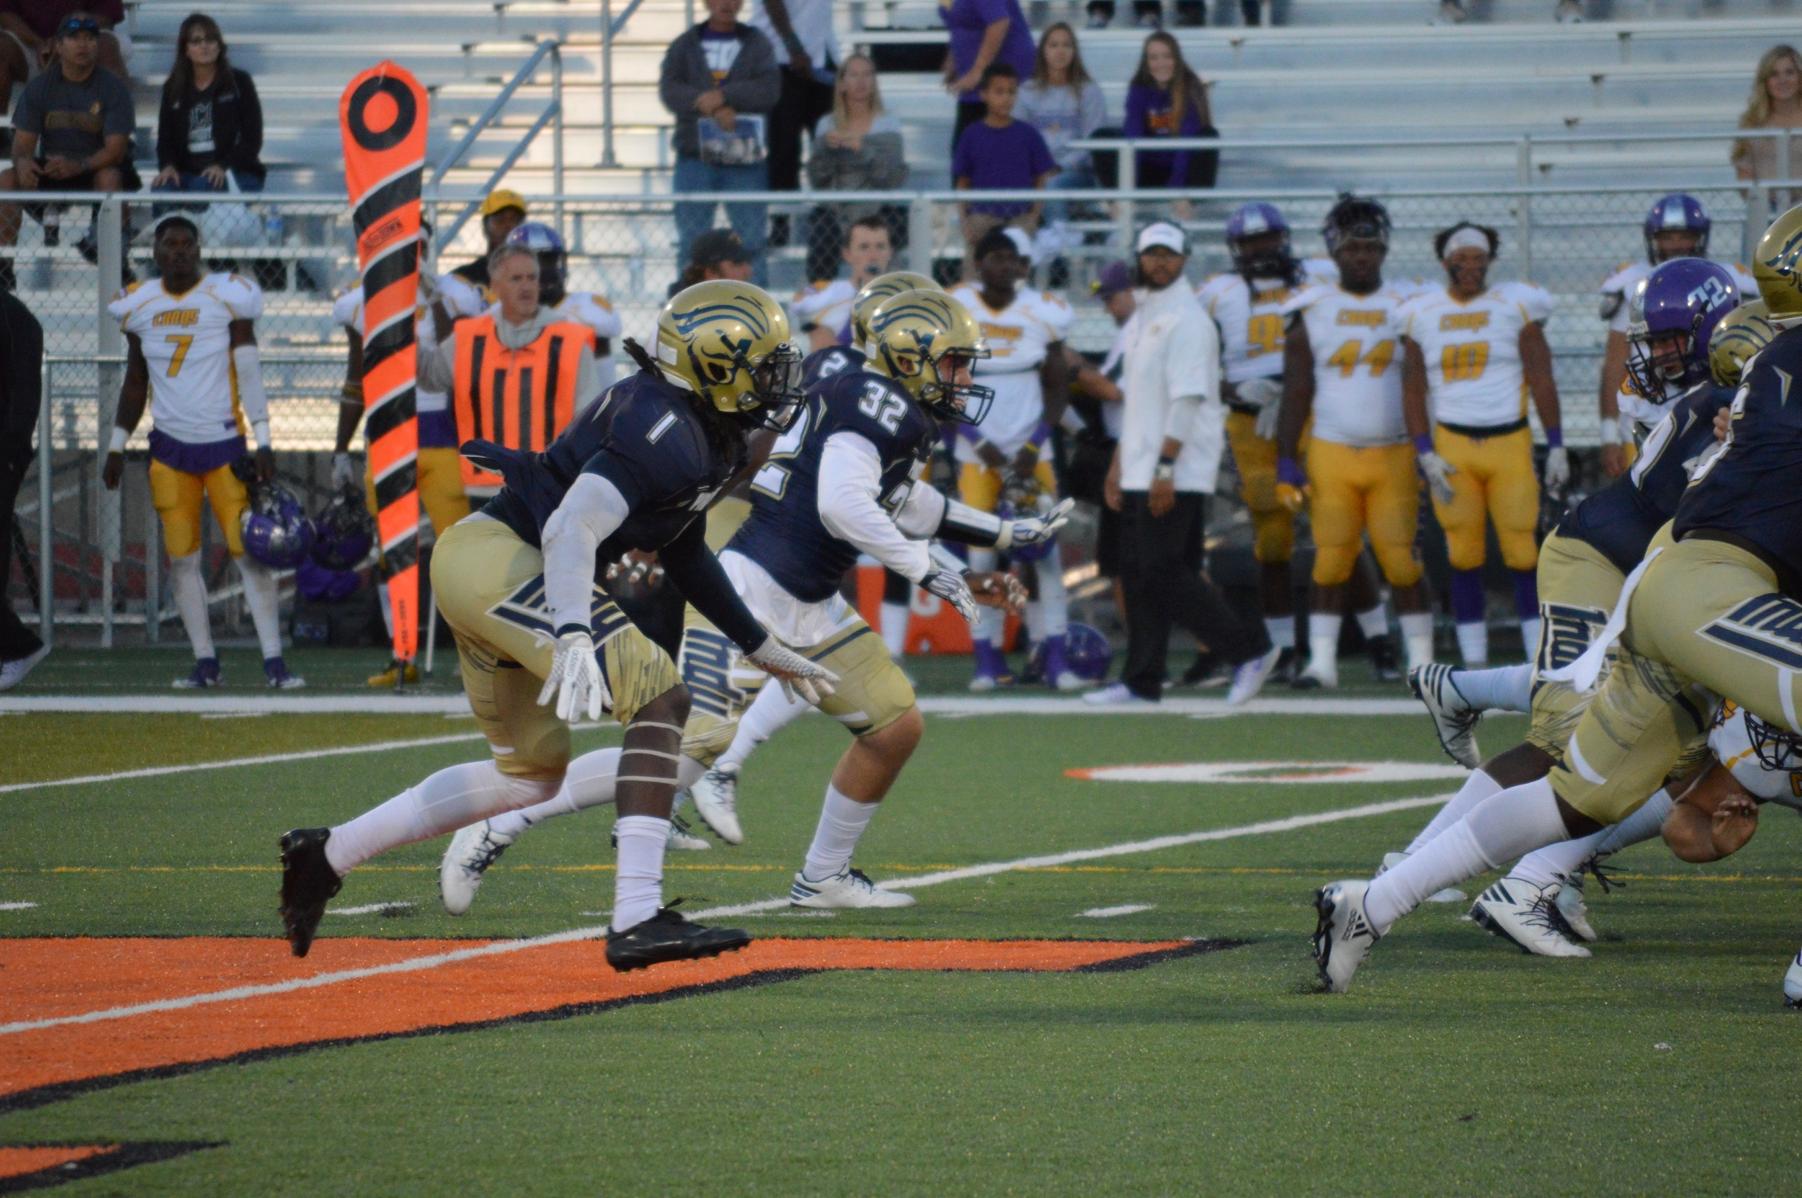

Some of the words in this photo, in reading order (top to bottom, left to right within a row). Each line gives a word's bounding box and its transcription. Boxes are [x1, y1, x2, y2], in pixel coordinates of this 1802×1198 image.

[164, 334, 194, 378] 7
[1326, 338, 1395, 379] 44
[1441, 340, 1490, 385] 10
[645, 410, 679, 445] 1
[858, 379, 909, 437] 32
